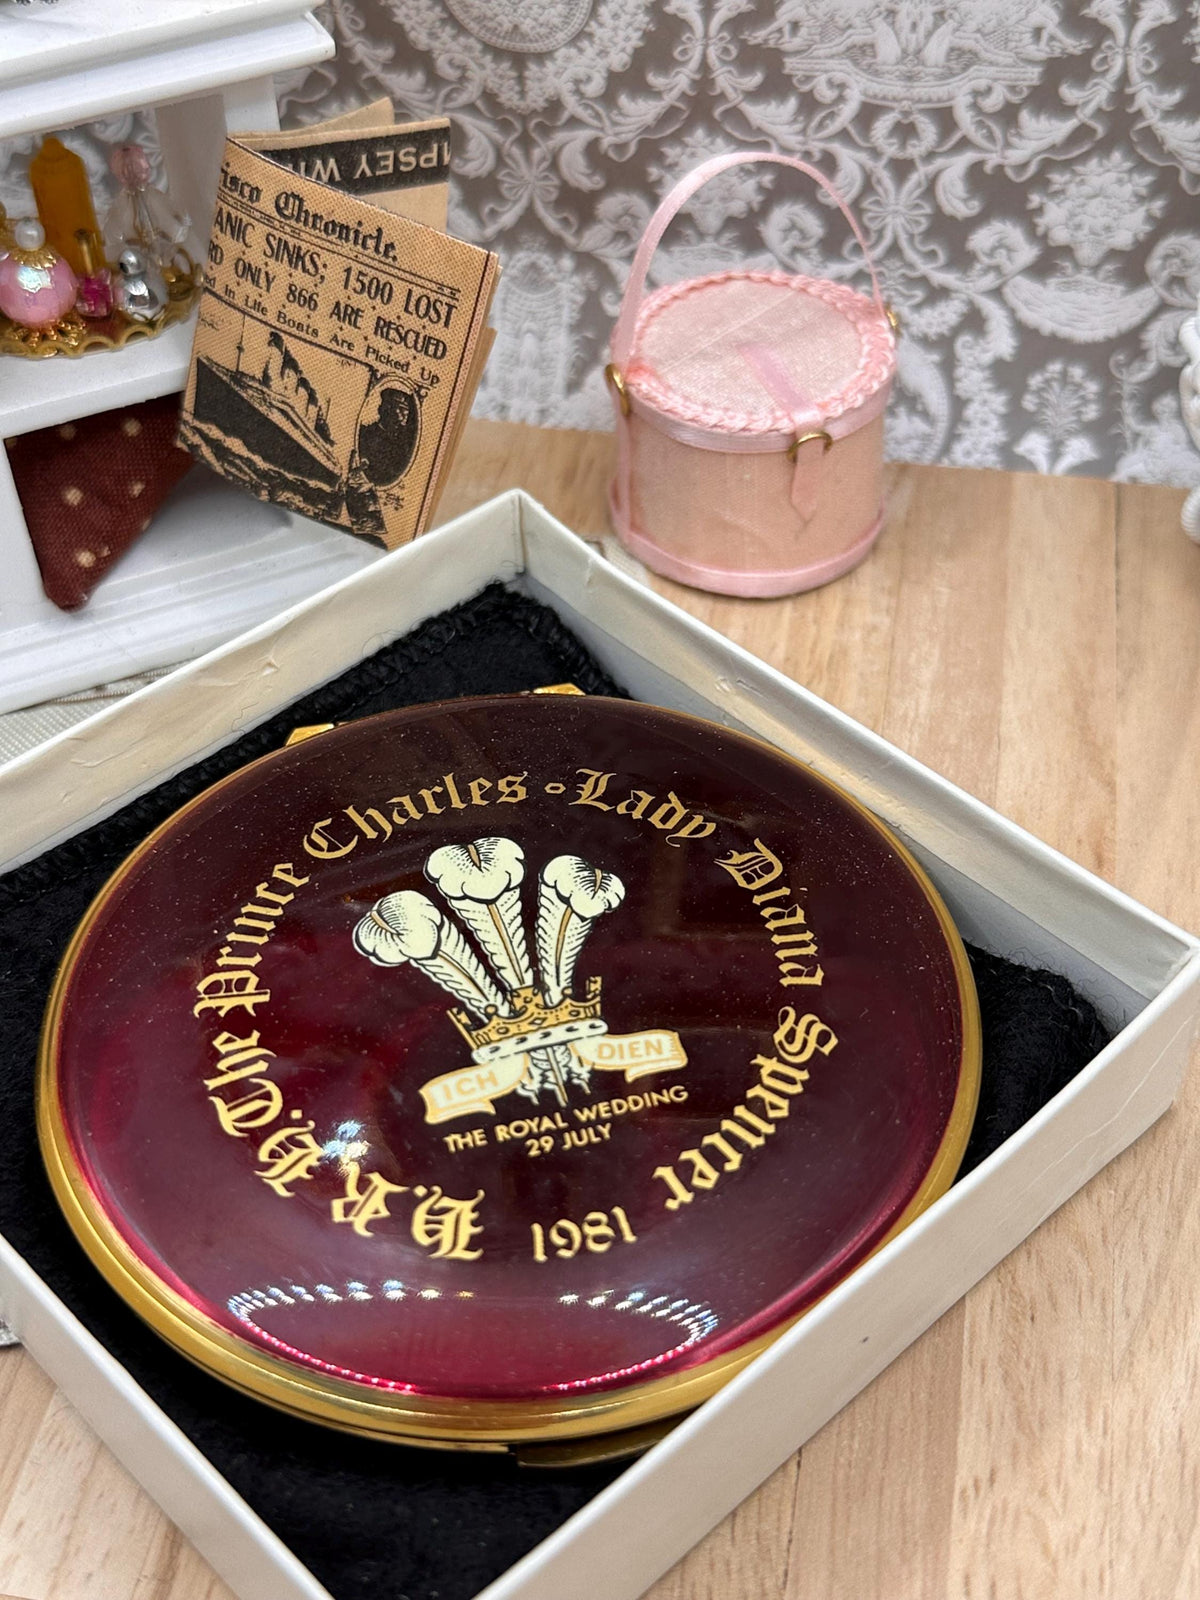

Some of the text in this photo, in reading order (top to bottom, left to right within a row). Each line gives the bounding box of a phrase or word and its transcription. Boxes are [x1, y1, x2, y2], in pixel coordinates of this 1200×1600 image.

[214, 206, 256, 249] ANIC
[263, 232, 329, 285] SINKS;
[342, 266, 395, 306] 1500
[403, 288, 458, 329] LOST
[275, 190, 399, 263] Chronicle.
[234, 257, 277, 294] ONLY
[286, 284, 319, 312] 866
[329, 300, 365, 331] ARE
[373, 316, 448, 361] RESCUED
[244, 297, 269, 317] Life
[276, 310, 320, 338] Boats
[329, 331, 356, 352] Are
[364, 345, 411, 374] Picked
[420, 366, 441, 386] Up
[303, 771, 529, 860] Charles
[568, 768, 717, 848] Lady
[193, 862, 311, 1019] Prince
[713, 838, 825, 988] Diana
[203, 1029, 284, 1138] The
[441, 1038, 664, 1099] ICH DIEN
[652, 1005, 840, 1212] Spencer
[443, 1085, 690, 1154] THE ROYAL WEDDING
[524, 1122, 613, 1158] 29 JULY
[530, 1206, 638, 1263] 1981
